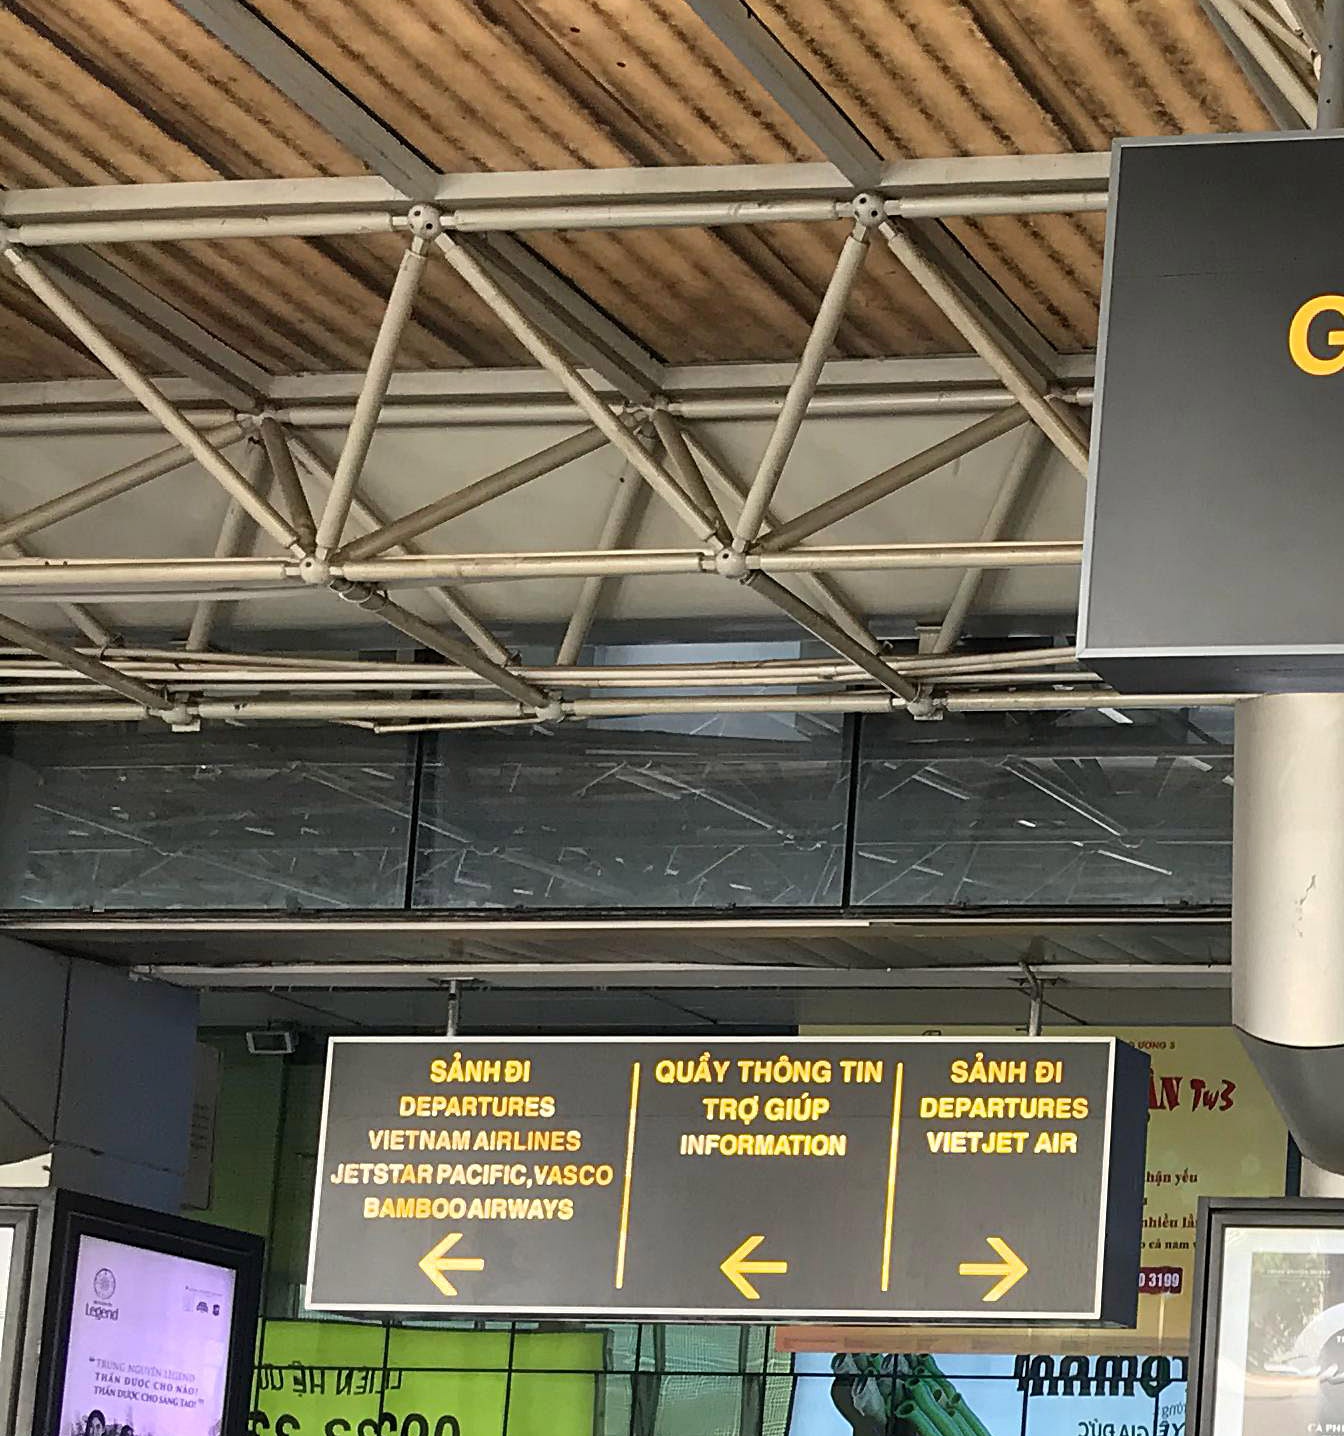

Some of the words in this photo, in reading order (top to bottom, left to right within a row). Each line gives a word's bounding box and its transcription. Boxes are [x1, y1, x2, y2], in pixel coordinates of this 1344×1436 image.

[430, 1052, 500, 1083] SẢNH
[504, 1060, 531, 1083] ĐI
[656, 1051, 729, 1083] QUẦY
[738, 1055, 832, 1083] THÔNG
[840, 1060, 882, 1083] TIN
[950, 1052, 1026, 1083] SẢNH
[1034, 1061, 1063, 1083] ĐI
[400, 1096, 556, 1118] DEPARTURES
[703, 1096, 759, 1124] TRỢ
[764, 1092, 830, 1121] GIÚP
[920, 1097, 1089, 1119] DEPARTURES
[368, 1130, 471, 1151] VIETNAM
[475, 1130, 581, 1151] AIRLINES
[680, 1134, 847, 1156] INFORMATION
[926, 1131, 1028, 1154] VIETJET
[1034, 1131, 1078, 1154] AIR
[330, 1163, 433, 1184] JETSTAR
